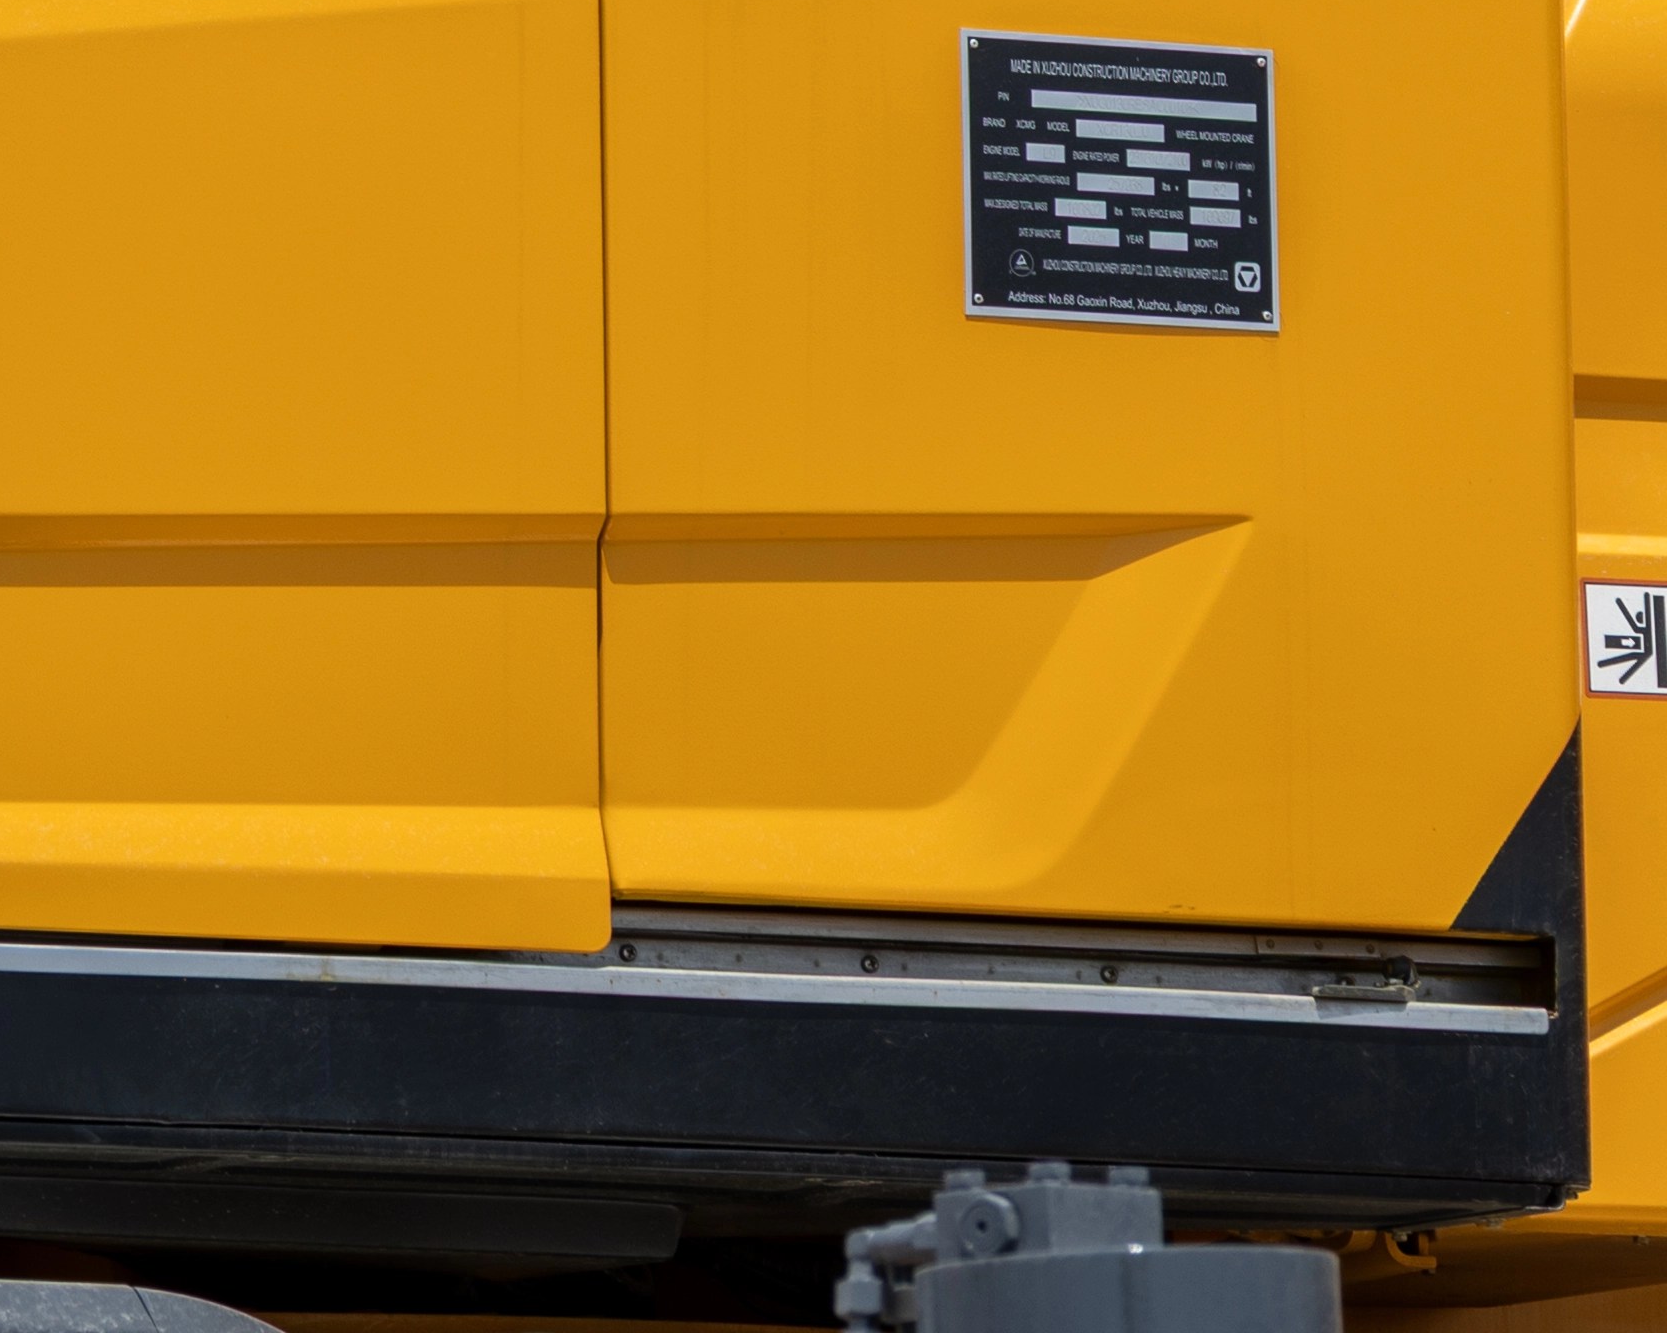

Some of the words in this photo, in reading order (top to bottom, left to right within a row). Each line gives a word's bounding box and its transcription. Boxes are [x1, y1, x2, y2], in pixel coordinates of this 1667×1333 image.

[1010, 59, 1031, 74] MADE
[1033, 61, 1040, 75] IN
[1042, 61, 1071, 77] XUZHOU
[1072, 62, 1129, 80] CONSTRUCTION
[1129, 66, 1172, 83] MACHINERY
[1172, 69, 1198, 85] GROUP
[997, 91, 1010, 101] PIN
[982, 117, 1006, 128] BRAND
[1047, 121, 1070, 132] MODEL
[1175, 130, 1198, 141] WHEEL
[1199, 131, 1231, 142] MOUNTED
[1232, 133, 1255, 144] CRANE
[1126, 234, 1144, 244] YEAR
[1194, 238, 1218, 249] MONTH
[1008, 290, 1046, 304] Address:
[1048, 293, 1075, 306] No.68
[1076, 294, 1108, 308] Gaoxin
[1109, 296, 1136, 311] Road,
[1137, 298, 1172, 313] Xuzhou,
[1214, 303, 1240, 316] China
